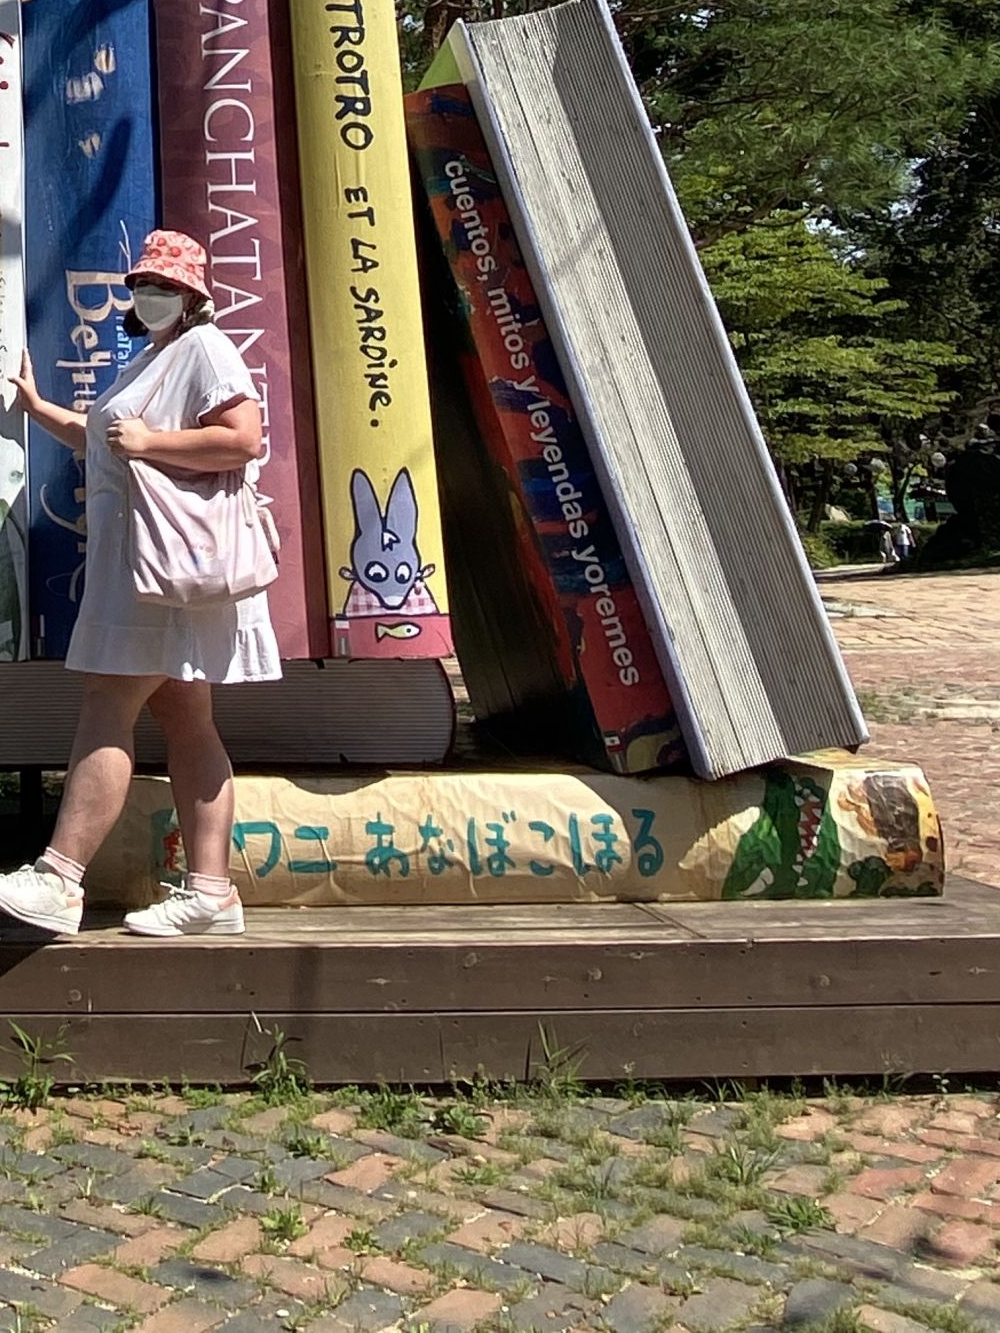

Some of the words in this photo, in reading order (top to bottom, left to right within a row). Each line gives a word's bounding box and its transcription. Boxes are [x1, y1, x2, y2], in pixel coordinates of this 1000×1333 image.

[344, 186, 376, 227] ET
[350, 237, 379, 273] LA
[443, 159, 498, 282] cuentos,
[487, 285, 532, 371] mitos
[511, 377, 538, 403] y
[527, 400, 589, 539] leyendas
[572, 544, 640, 688] yoremes
